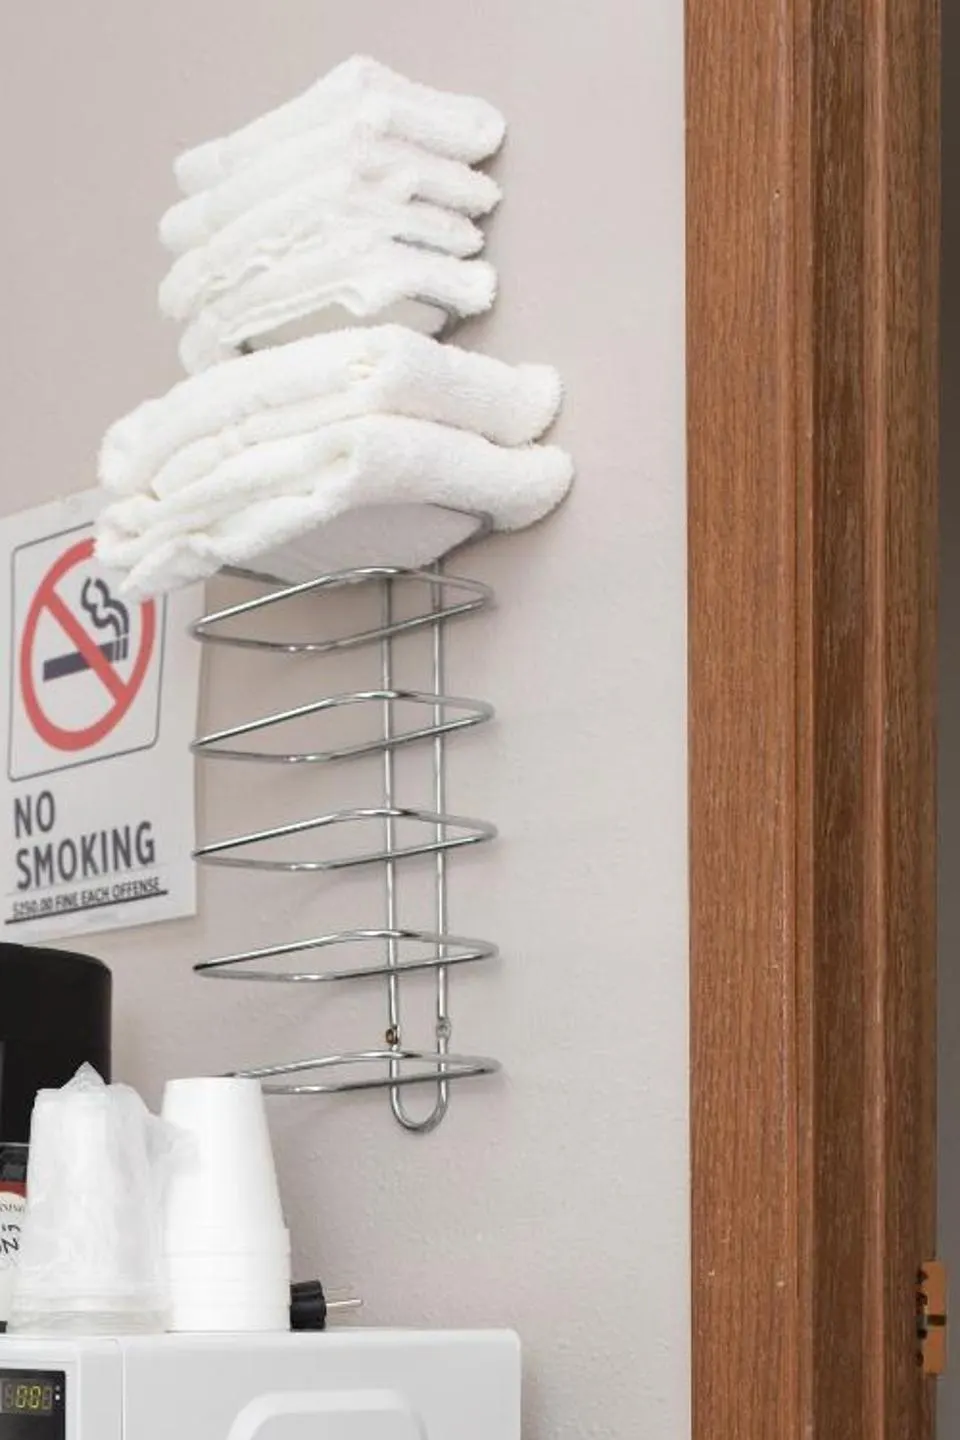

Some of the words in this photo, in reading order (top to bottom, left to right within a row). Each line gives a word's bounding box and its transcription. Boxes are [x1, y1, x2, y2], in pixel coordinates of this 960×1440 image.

[14, 790, 55, 838] NO
[16, 821, 155, 890] SMOKING
[55, 892, 79, 910] FINE
[81, 886, 110, 905] EACH
[112, 876, 161, 899] OFFENSE
